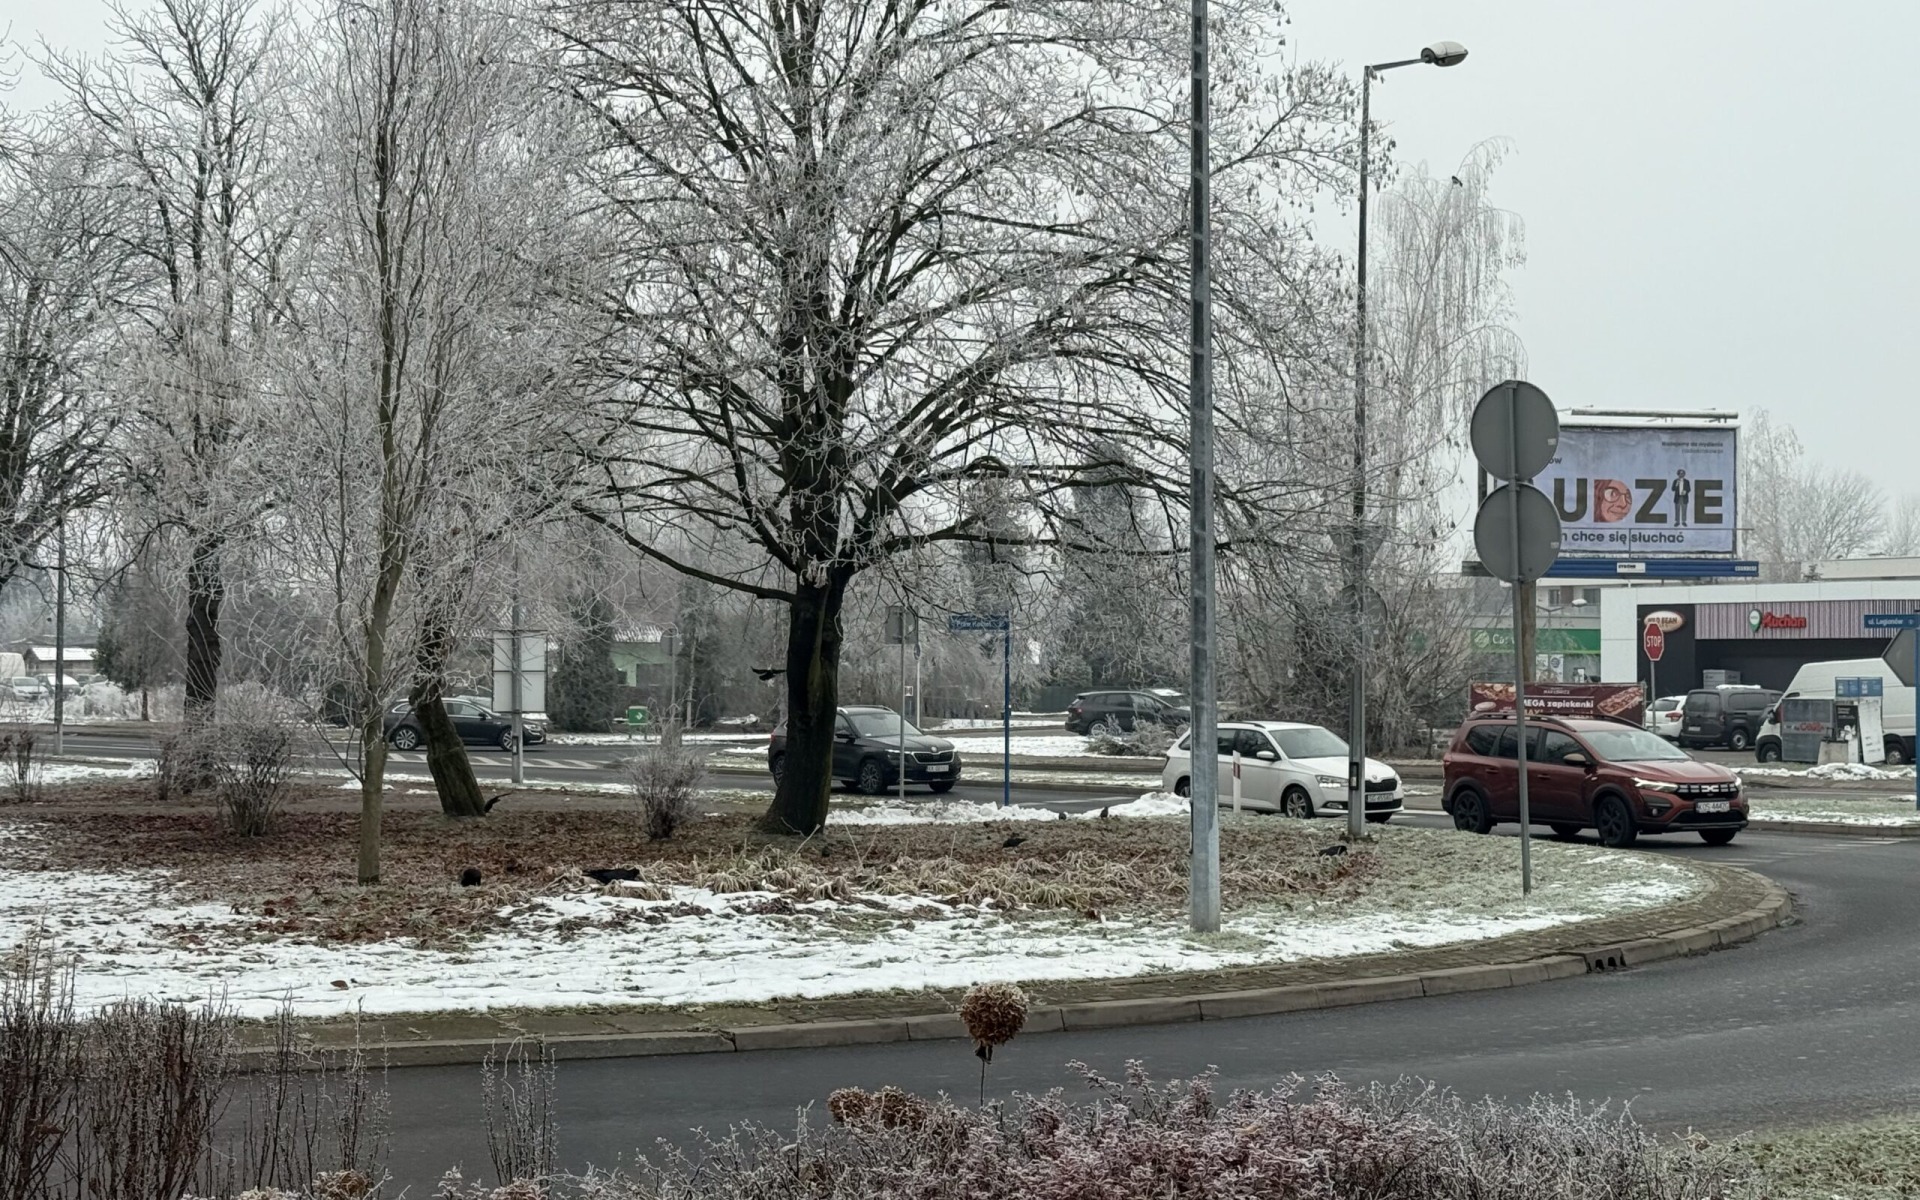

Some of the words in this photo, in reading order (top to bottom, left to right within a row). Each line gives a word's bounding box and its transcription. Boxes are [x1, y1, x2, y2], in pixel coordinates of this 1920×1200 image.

[1553, 469, 1723, 527] UDZIE
[1571, 531, 1605, 542] chce
[1608, 531, 1627, 545] się
[1630, 532, 1685, 543] słuchać
[1763, 612, 1806, 628] Auchan
[1646, 635, 1662, 648] STOP
[1547, 700, 1594, 709] zapiekanki
